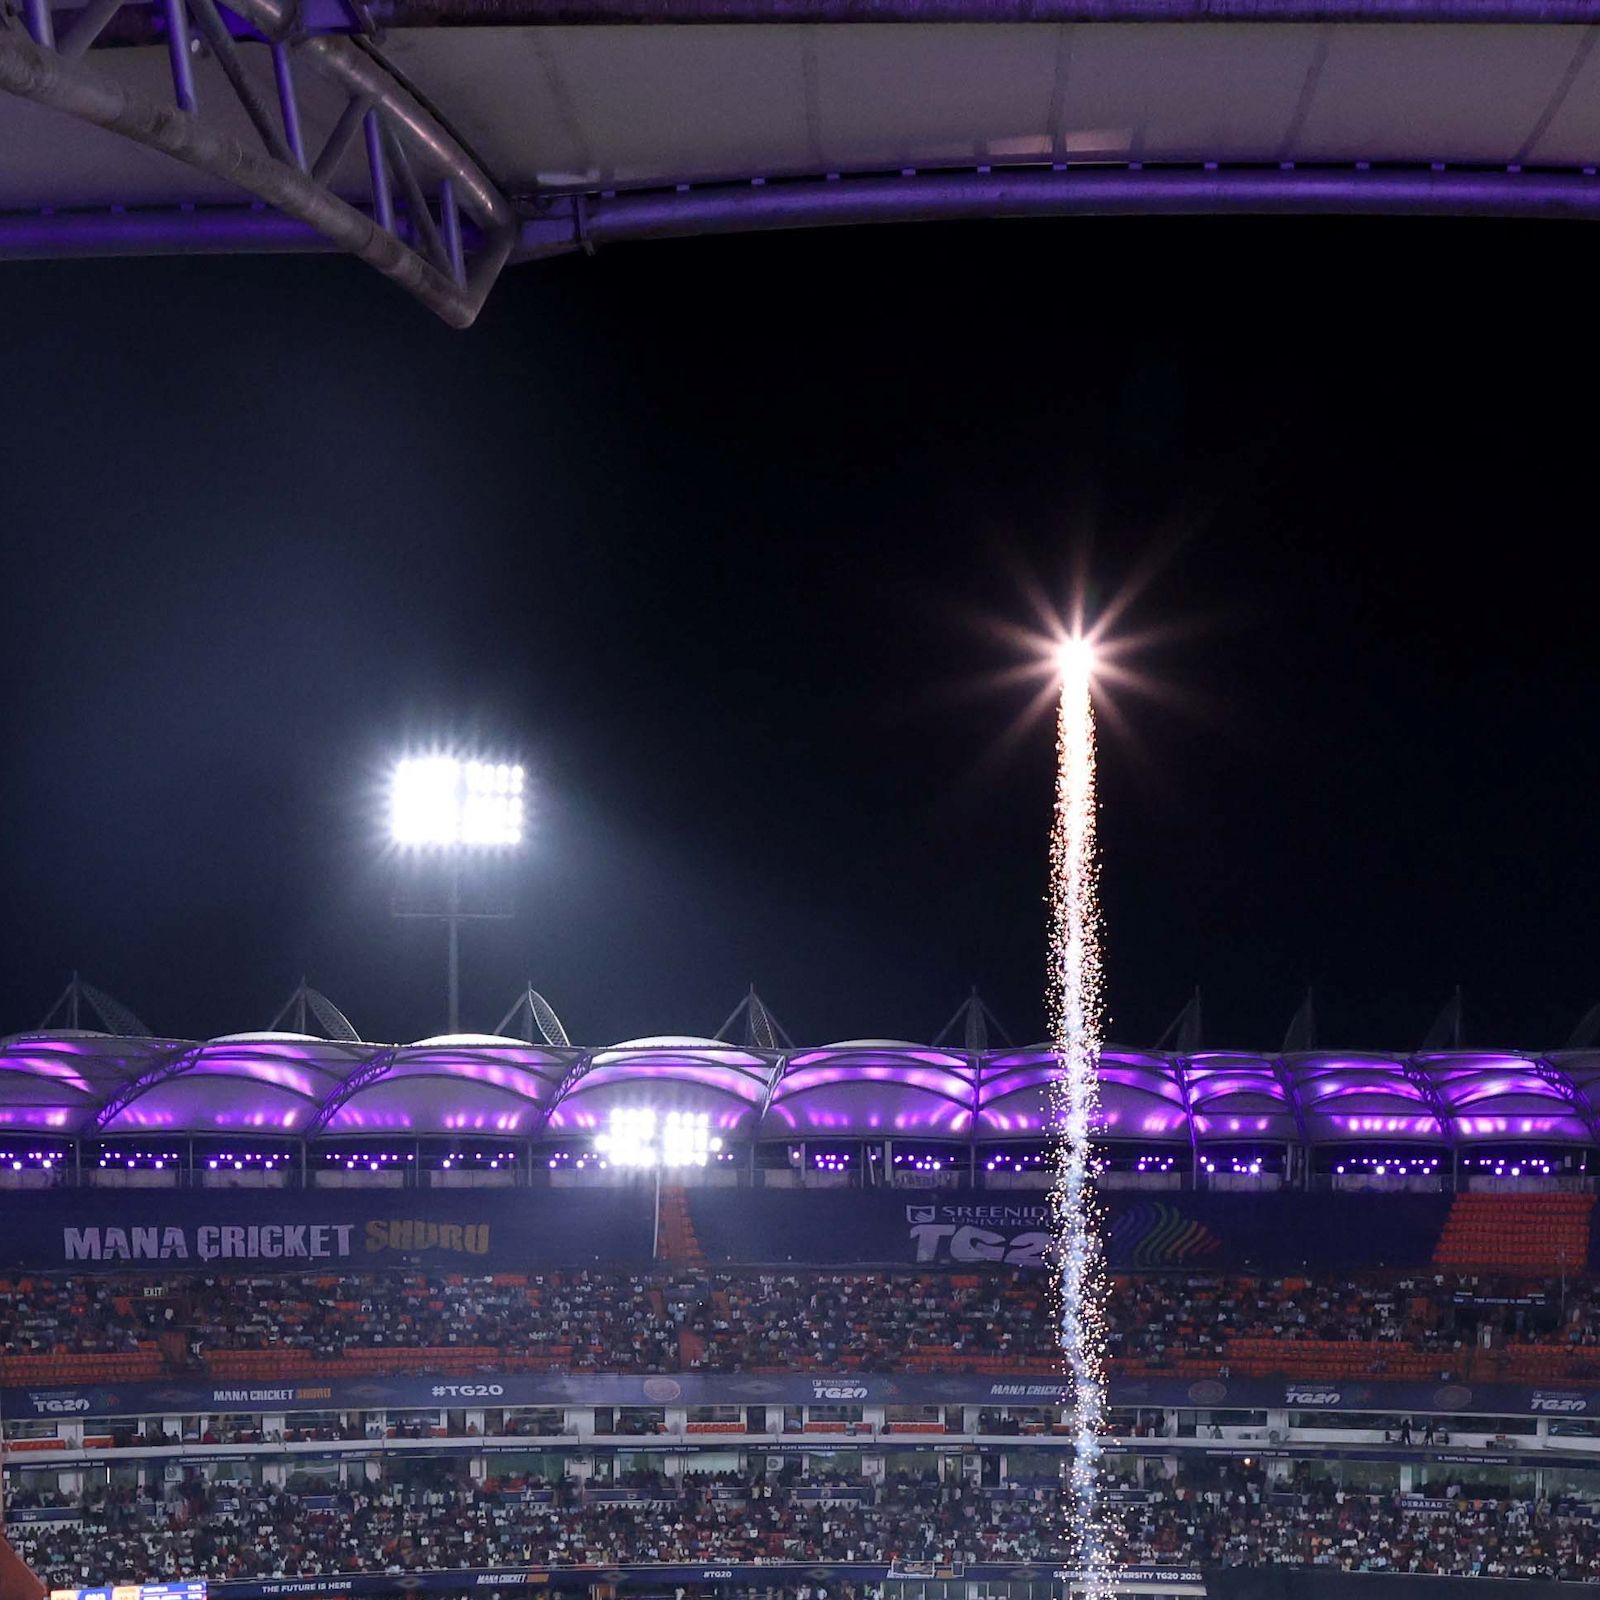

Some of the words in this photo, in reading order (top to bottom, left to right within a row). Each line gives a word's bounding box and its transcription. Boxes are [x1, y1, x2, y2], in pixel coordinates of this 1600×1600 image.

[63, 1226, 188, 1260] MANA
[197, 1223, 354, 1259] CRICKET
[909, 1224, 1052, 1267] TG2
[213, 1389, 248, 1402] MANA
[249, 1388, 294, 1401] CRICKET
[431, 1383, 504, 1397] #TG20
[813, 1387, 869, 1400] TG20
[33, 1399, 90, 1413] TG20
[703, 1570, 733, 1579] #TG20
[262, 1585, 279, 1594] THE
[280, 1583, 316, 1593] FUTURE
[317, 1582, 326, 1590] IS
[328, 1581, 352, 1590] HERE
